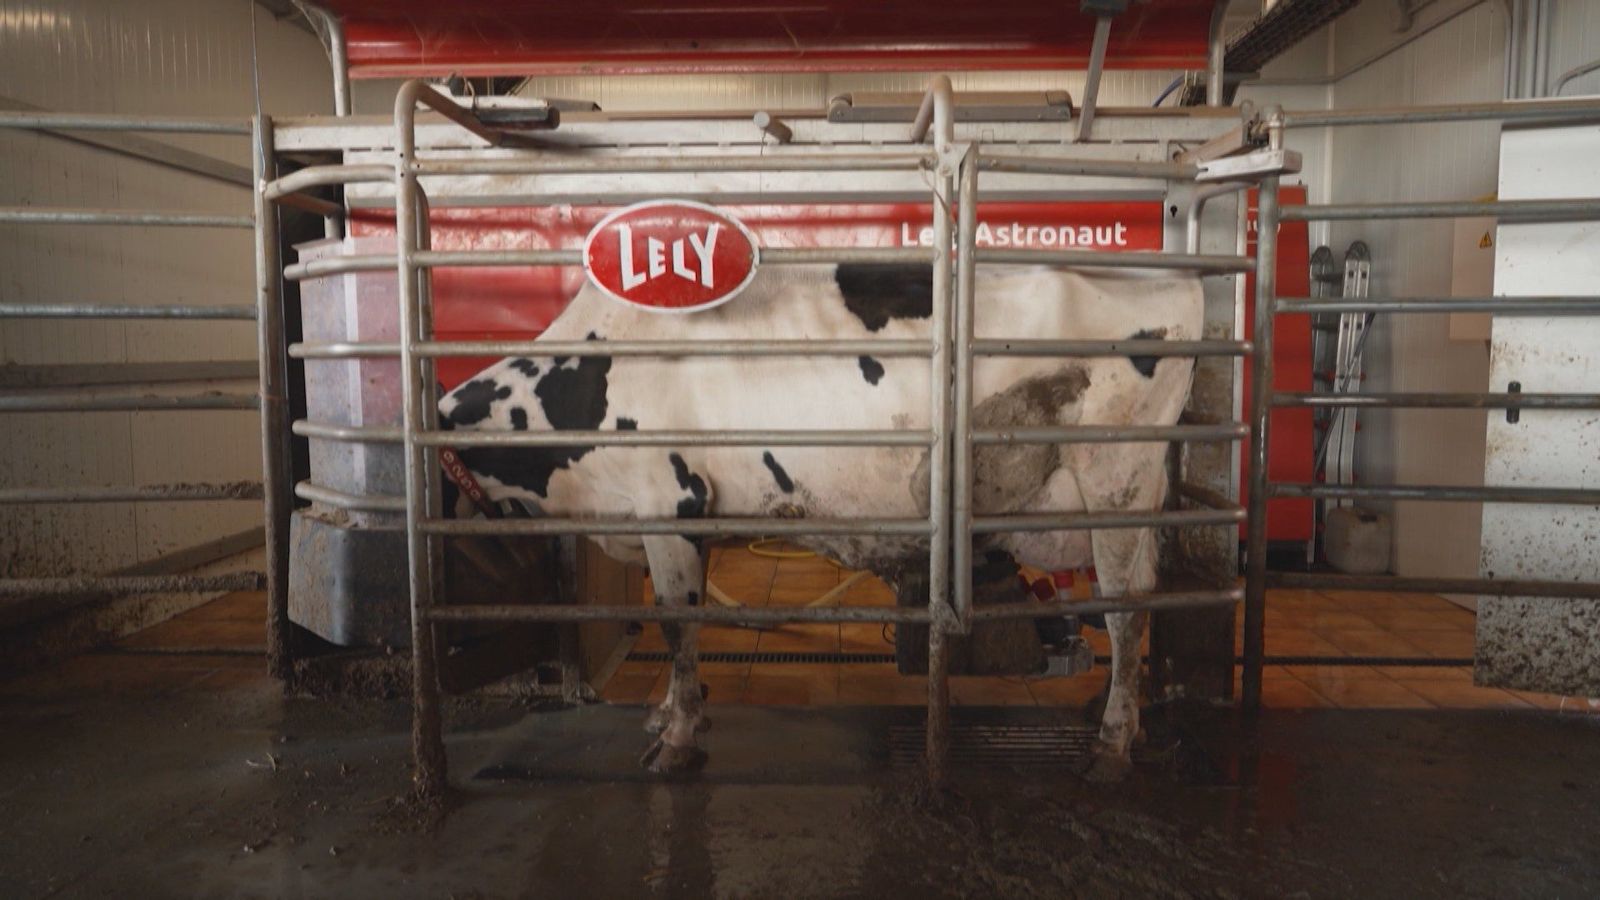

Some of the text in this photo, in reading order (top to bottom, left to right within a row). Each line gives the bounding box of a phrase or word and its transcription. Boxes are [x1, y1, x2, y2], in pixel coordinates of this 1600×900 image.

[619, 222, 720, 291] LELY
[902, 221, 1128, 251] Le Astronaut
